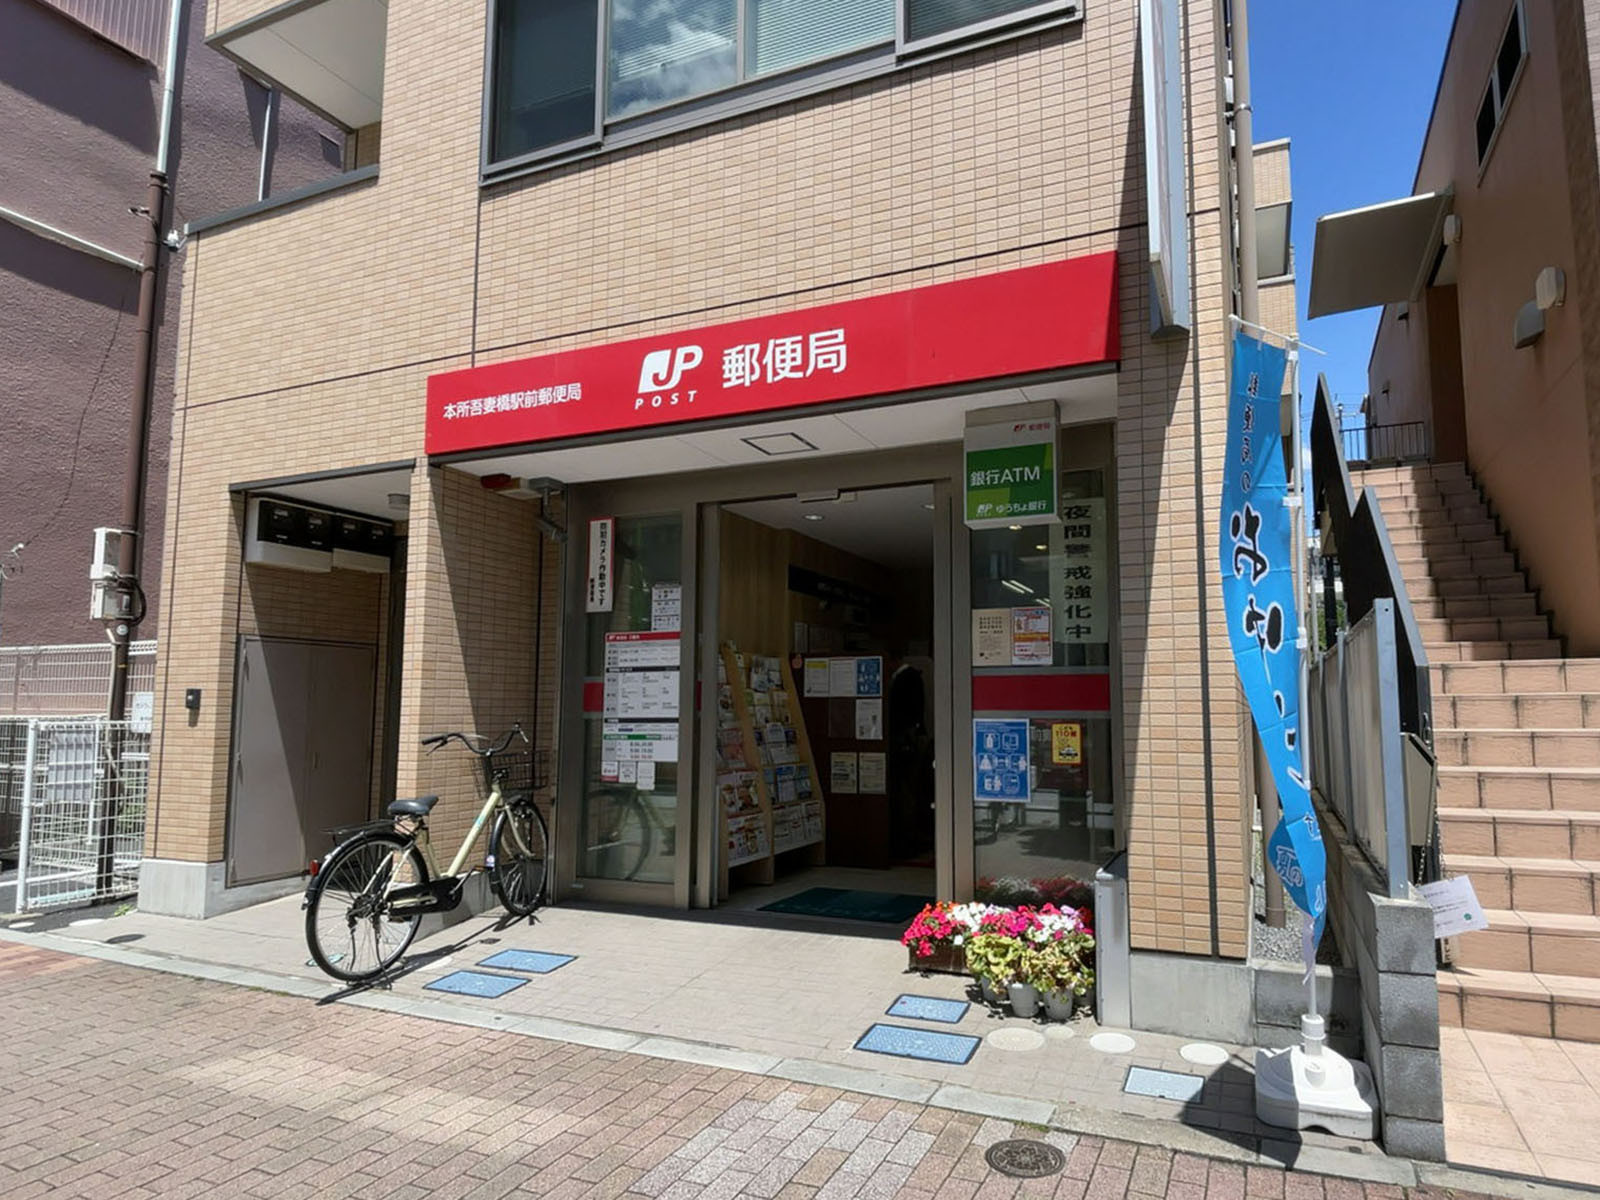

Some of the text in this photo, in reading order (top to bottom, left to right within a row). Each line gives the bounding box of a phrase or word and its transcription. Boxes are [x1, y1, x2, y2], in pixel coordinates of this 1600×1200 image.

[637, 345, 703, 393] JP
[721, 328, 848, 389] 郵便局
[443, 382, 583, 421] 本所吾妻橋駅前郵便局
[633, 389, 699, 411] POST
[970, 466, 1041, 487] 銀行ATM
[995, 500, 1048, 513] ゆうちょ銀行
[1063, 504, 1092, 638] 夜間警戒強化中
